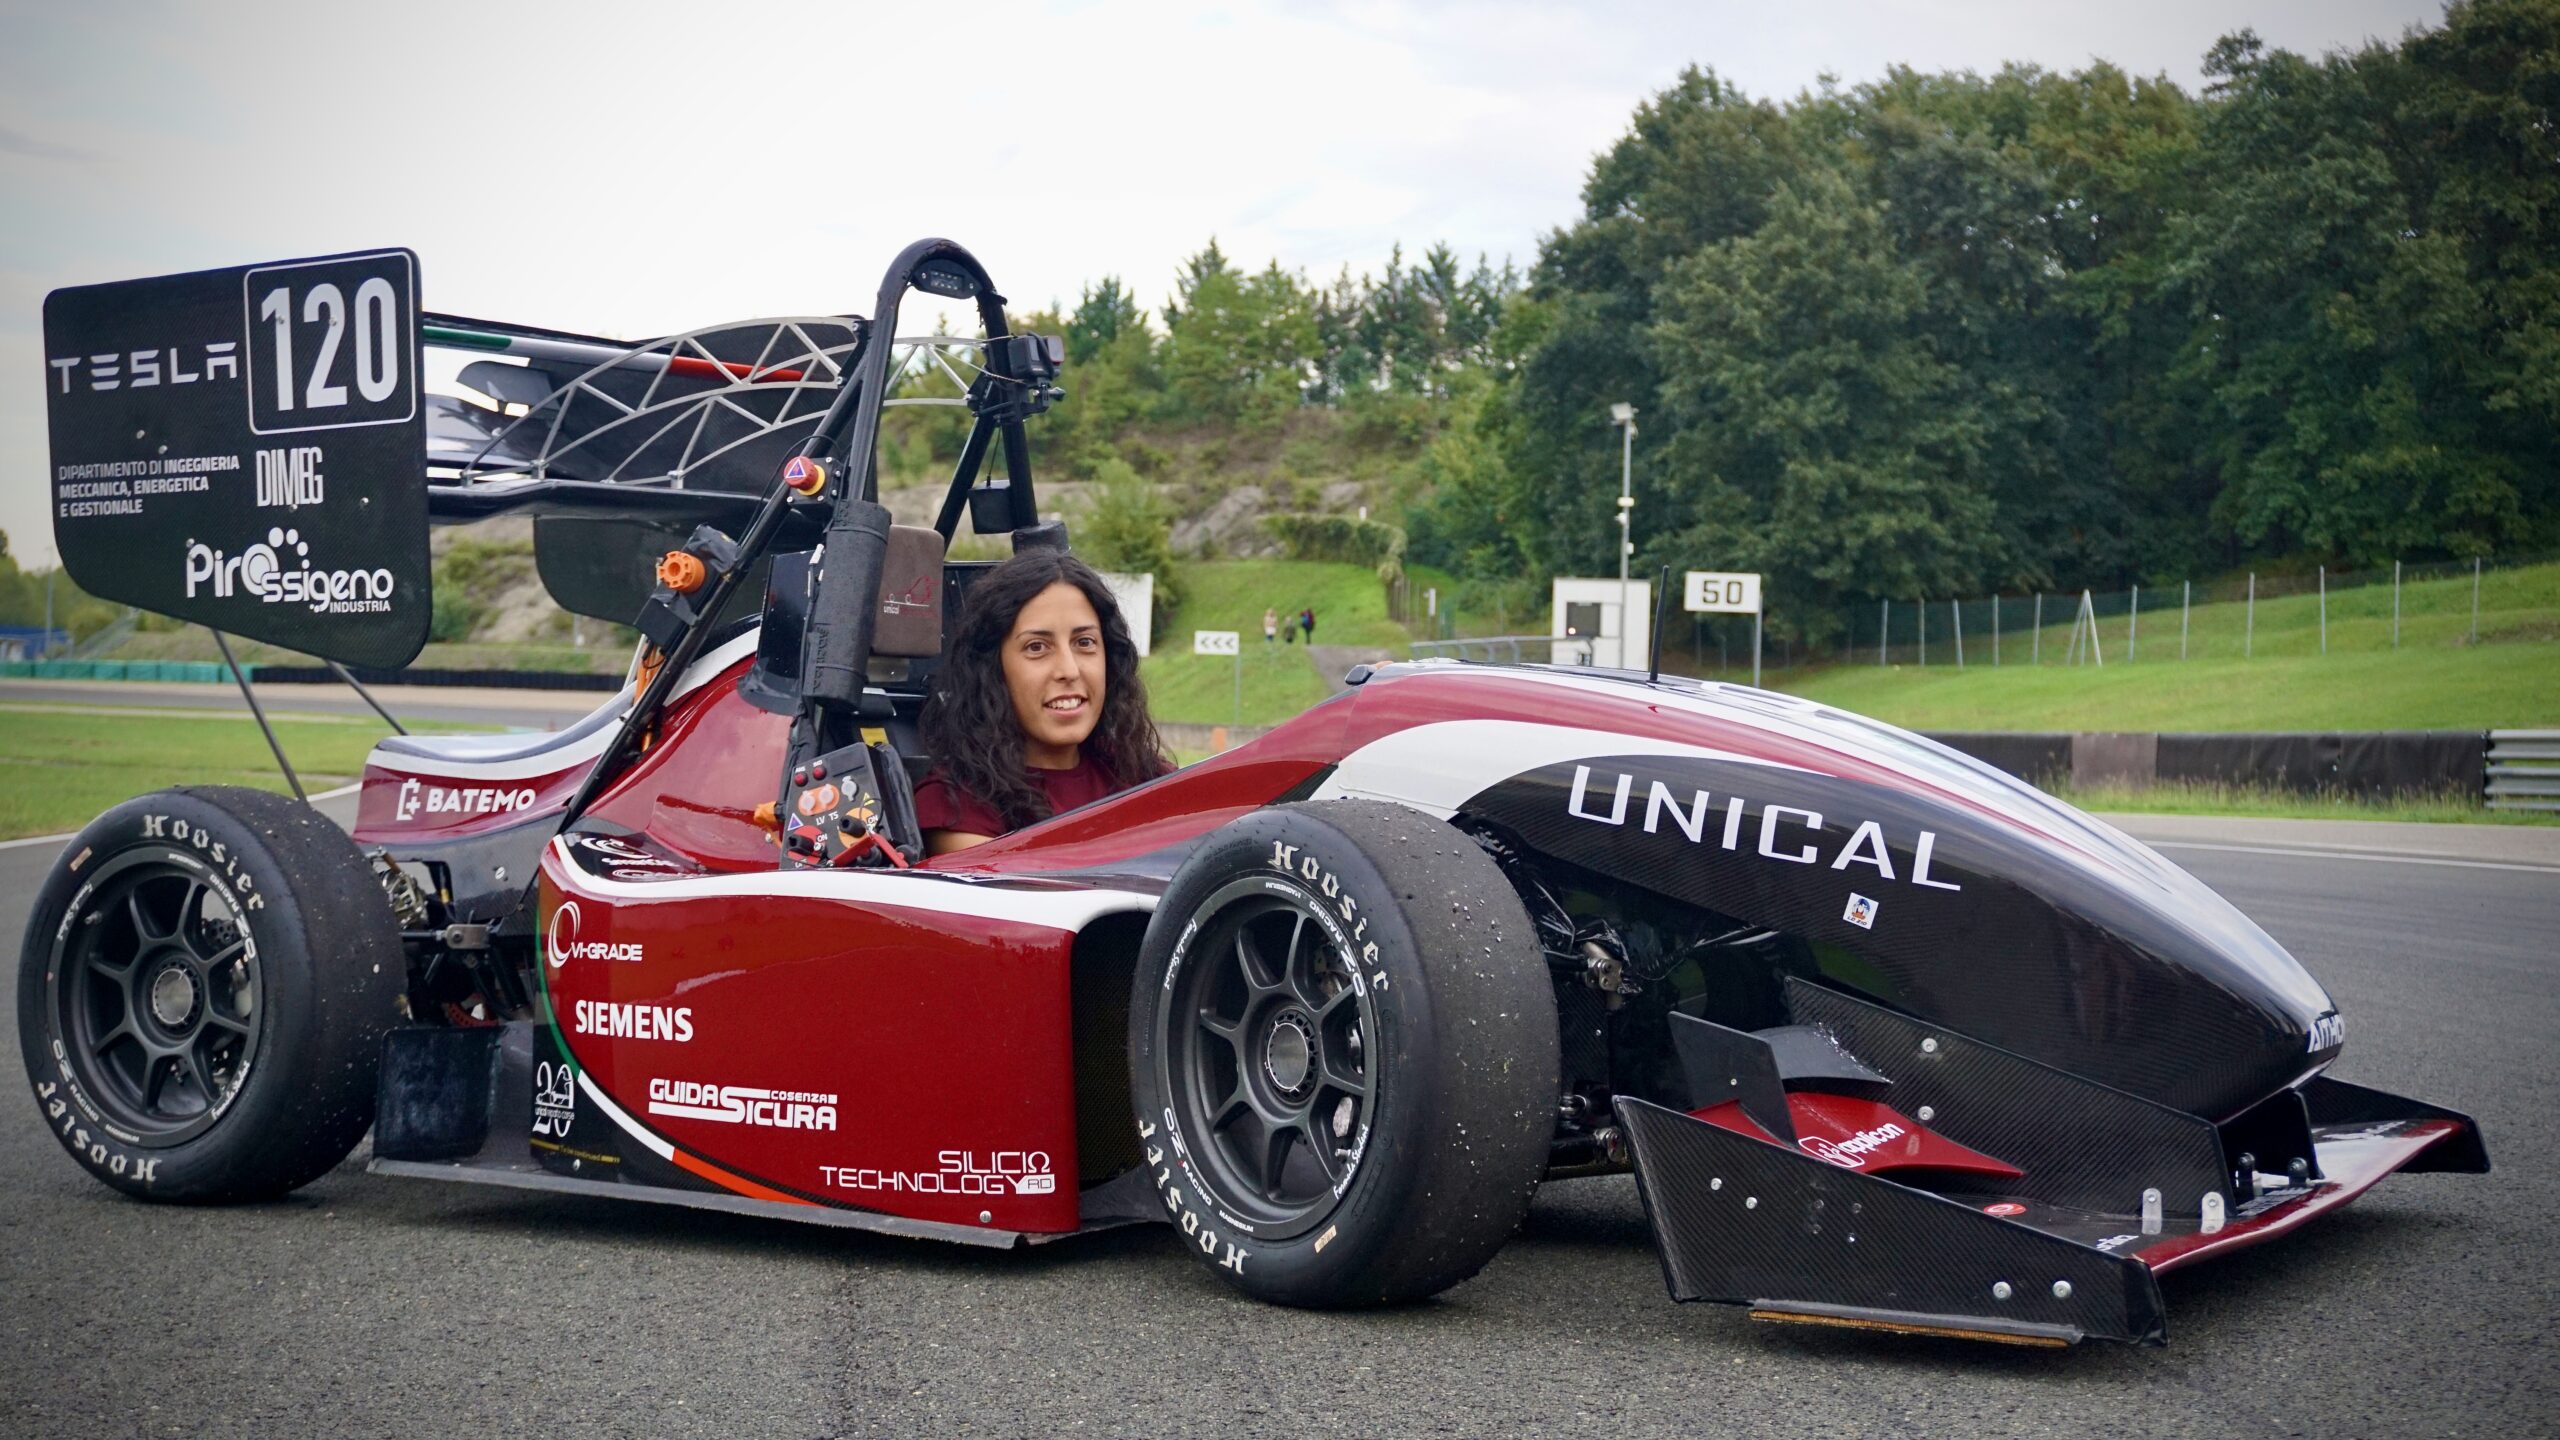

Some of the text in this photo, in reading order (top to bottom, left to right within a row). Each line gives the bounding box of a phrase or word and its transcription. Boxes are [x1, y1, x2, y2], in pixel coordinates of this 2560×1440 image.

[261, 277, 398, 412] 120
[50, 342, 237, 394] TESLA
[58, 455, 240, 480] DIPARTIMENTO DI INGEGNERIA
[59, 476, 210, 499] MECCANICA, ENERGETICA
[255, 447, 324, 507] DIMEG
[60, 499, 143, 518] E GESTIONALE
[330, 600, 391, 614] INDUSTRIA
[1703, 580, 1742, 604] 50
[426, 788, 536, 812] BATEMO
[1568, 765, 1961, 891] UNICAL
[140, 814, 264, 910] Hoosier
[1267, 840, 1389, 992] Hoosier
[1309, 900, 1343, 943] RACING
[571, 941, 643, 961] VI-GRADE
[575, 1000, 694, 1042] SIEMENS
[649, 1078, 719, 1107] GUIDA
[719, 1086, 837, 1131] SICURA
[770, 1090, 828, 1104] COSENZA
[38, 1082, 162, 1181] Hoosier
[1838, 1122, 1906, 1154] applicon
[819, 1165, 1028, 1195] TECHNOLOGY
[1138, 1119, 1252, 1275] Hoosier
[1182, 1160, 1212, 1207] RACING
